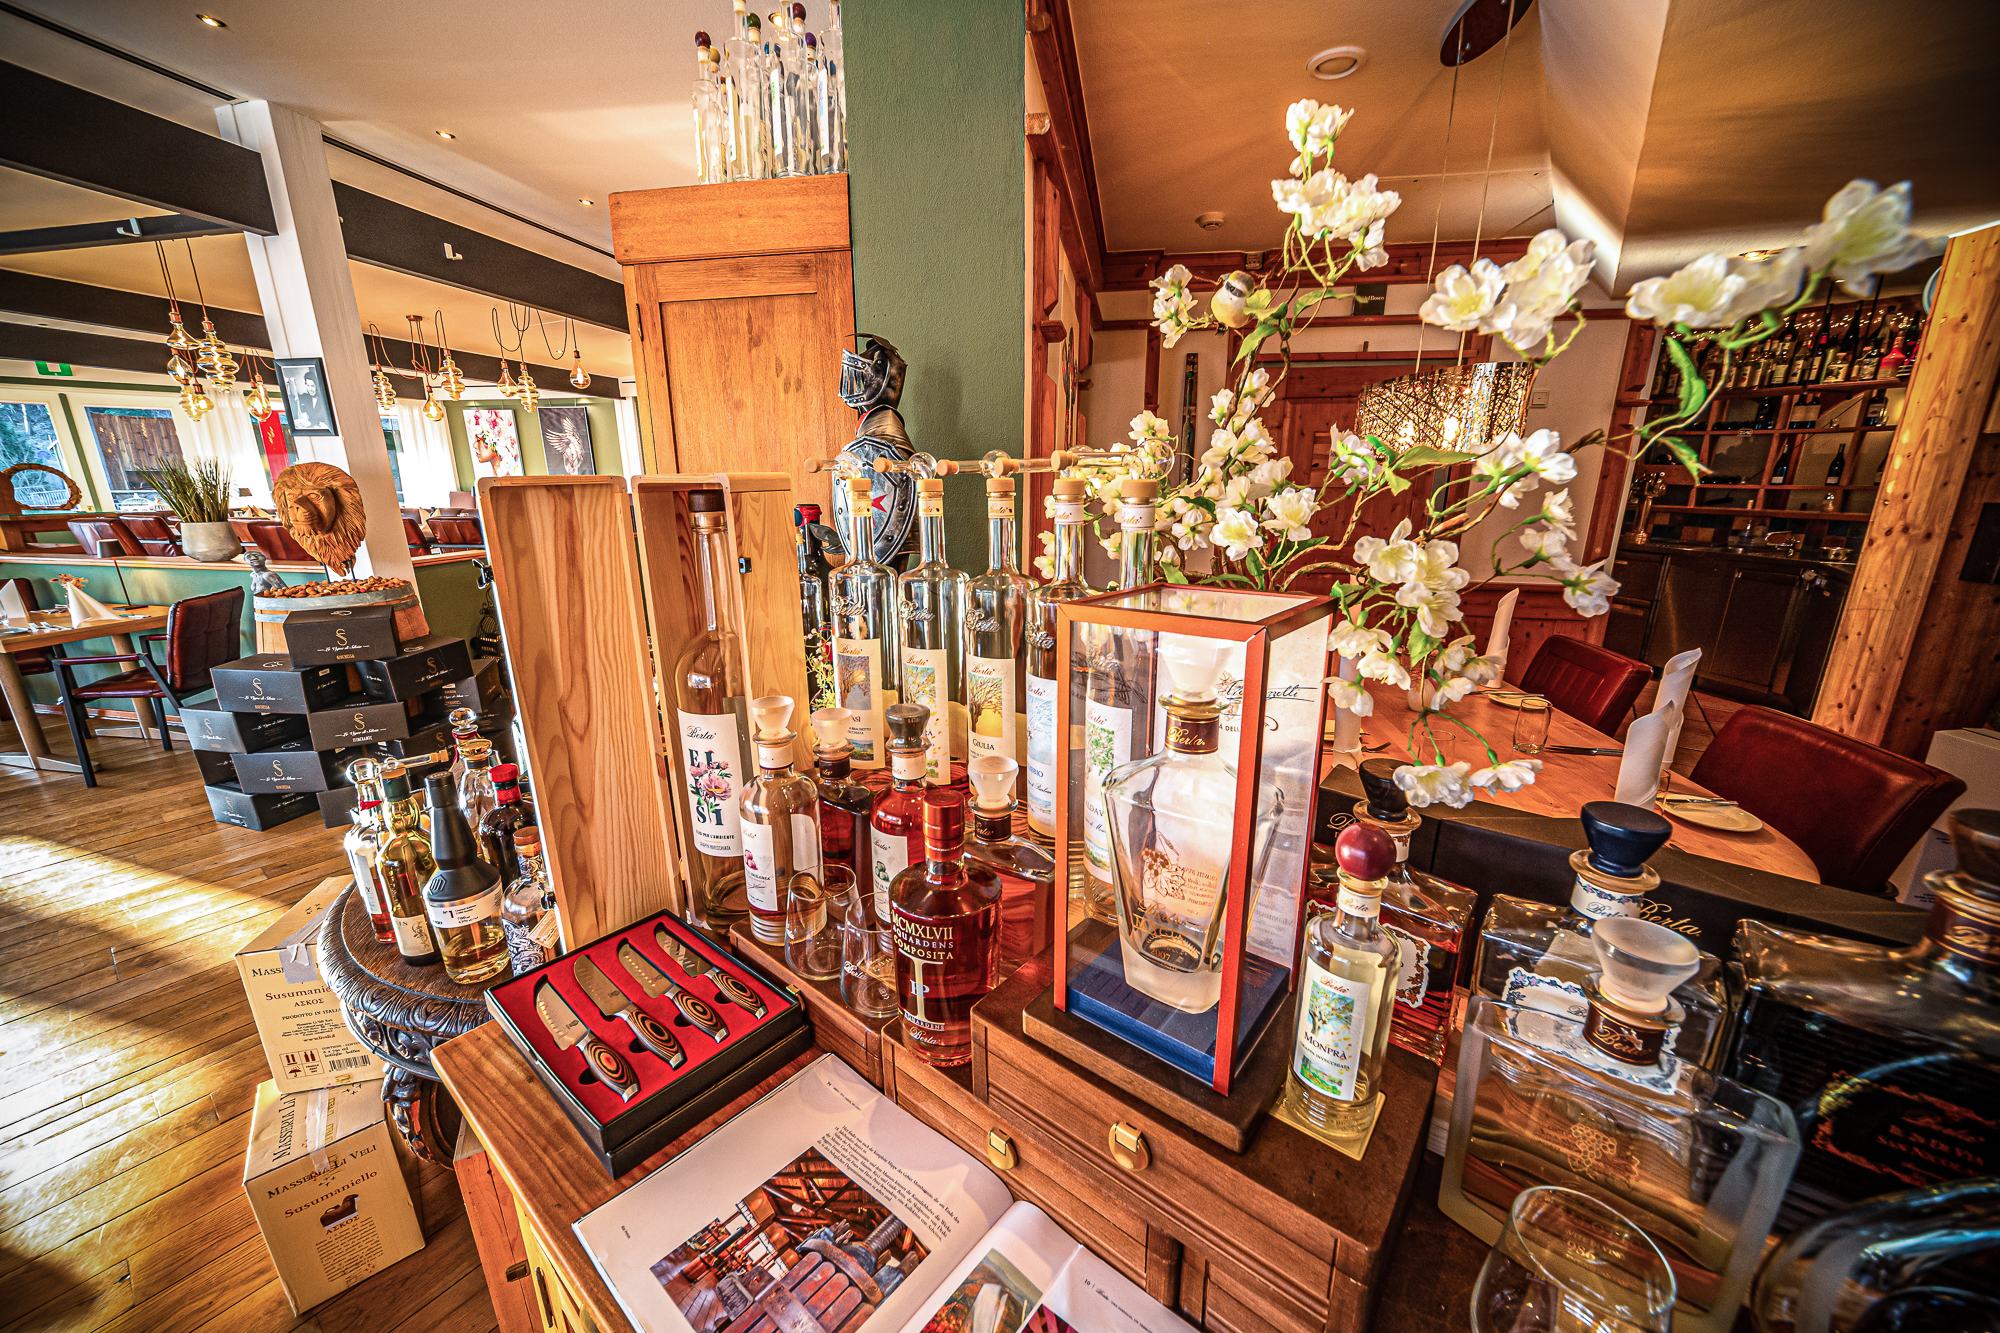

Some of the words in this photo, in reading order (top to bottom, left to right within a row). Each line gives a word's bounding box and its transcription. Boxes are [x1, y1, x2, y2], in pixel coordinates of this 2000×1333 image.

[840, 643, 861, 655] Berta
[906, 653, 927, 666] Berta
[971, 662, 993, 676] Berta
[686, 725, 715, 740] Berta
[1167, 725, 1203, 746] Berta
[972, 738, 995, 751] GIULIA
[1340, 898, 1369, 912] Berta
[891, 910, 953, 940] MCMXLVII
[1639, 898, 1702, 937] Berta
[892, 924, 954, 949] AQUARDENS
[893, 934, 954, 960] COMPOSITA
[1319, 974, 1349, 995] Berta
[282, 1011, 313, 1021] PRODOTTO
[909, 1027, 937, 1045] Berta
[1304, 1030, 1348, 1061] MONPRÀ
[272, 1110, 295, 1162] MASSERIA
[266, 1166, 330, 1200] MASSERIA
[350, 1144, 377, 1160] VELI
[284, 1170, 378, 1219] Susumaniello
